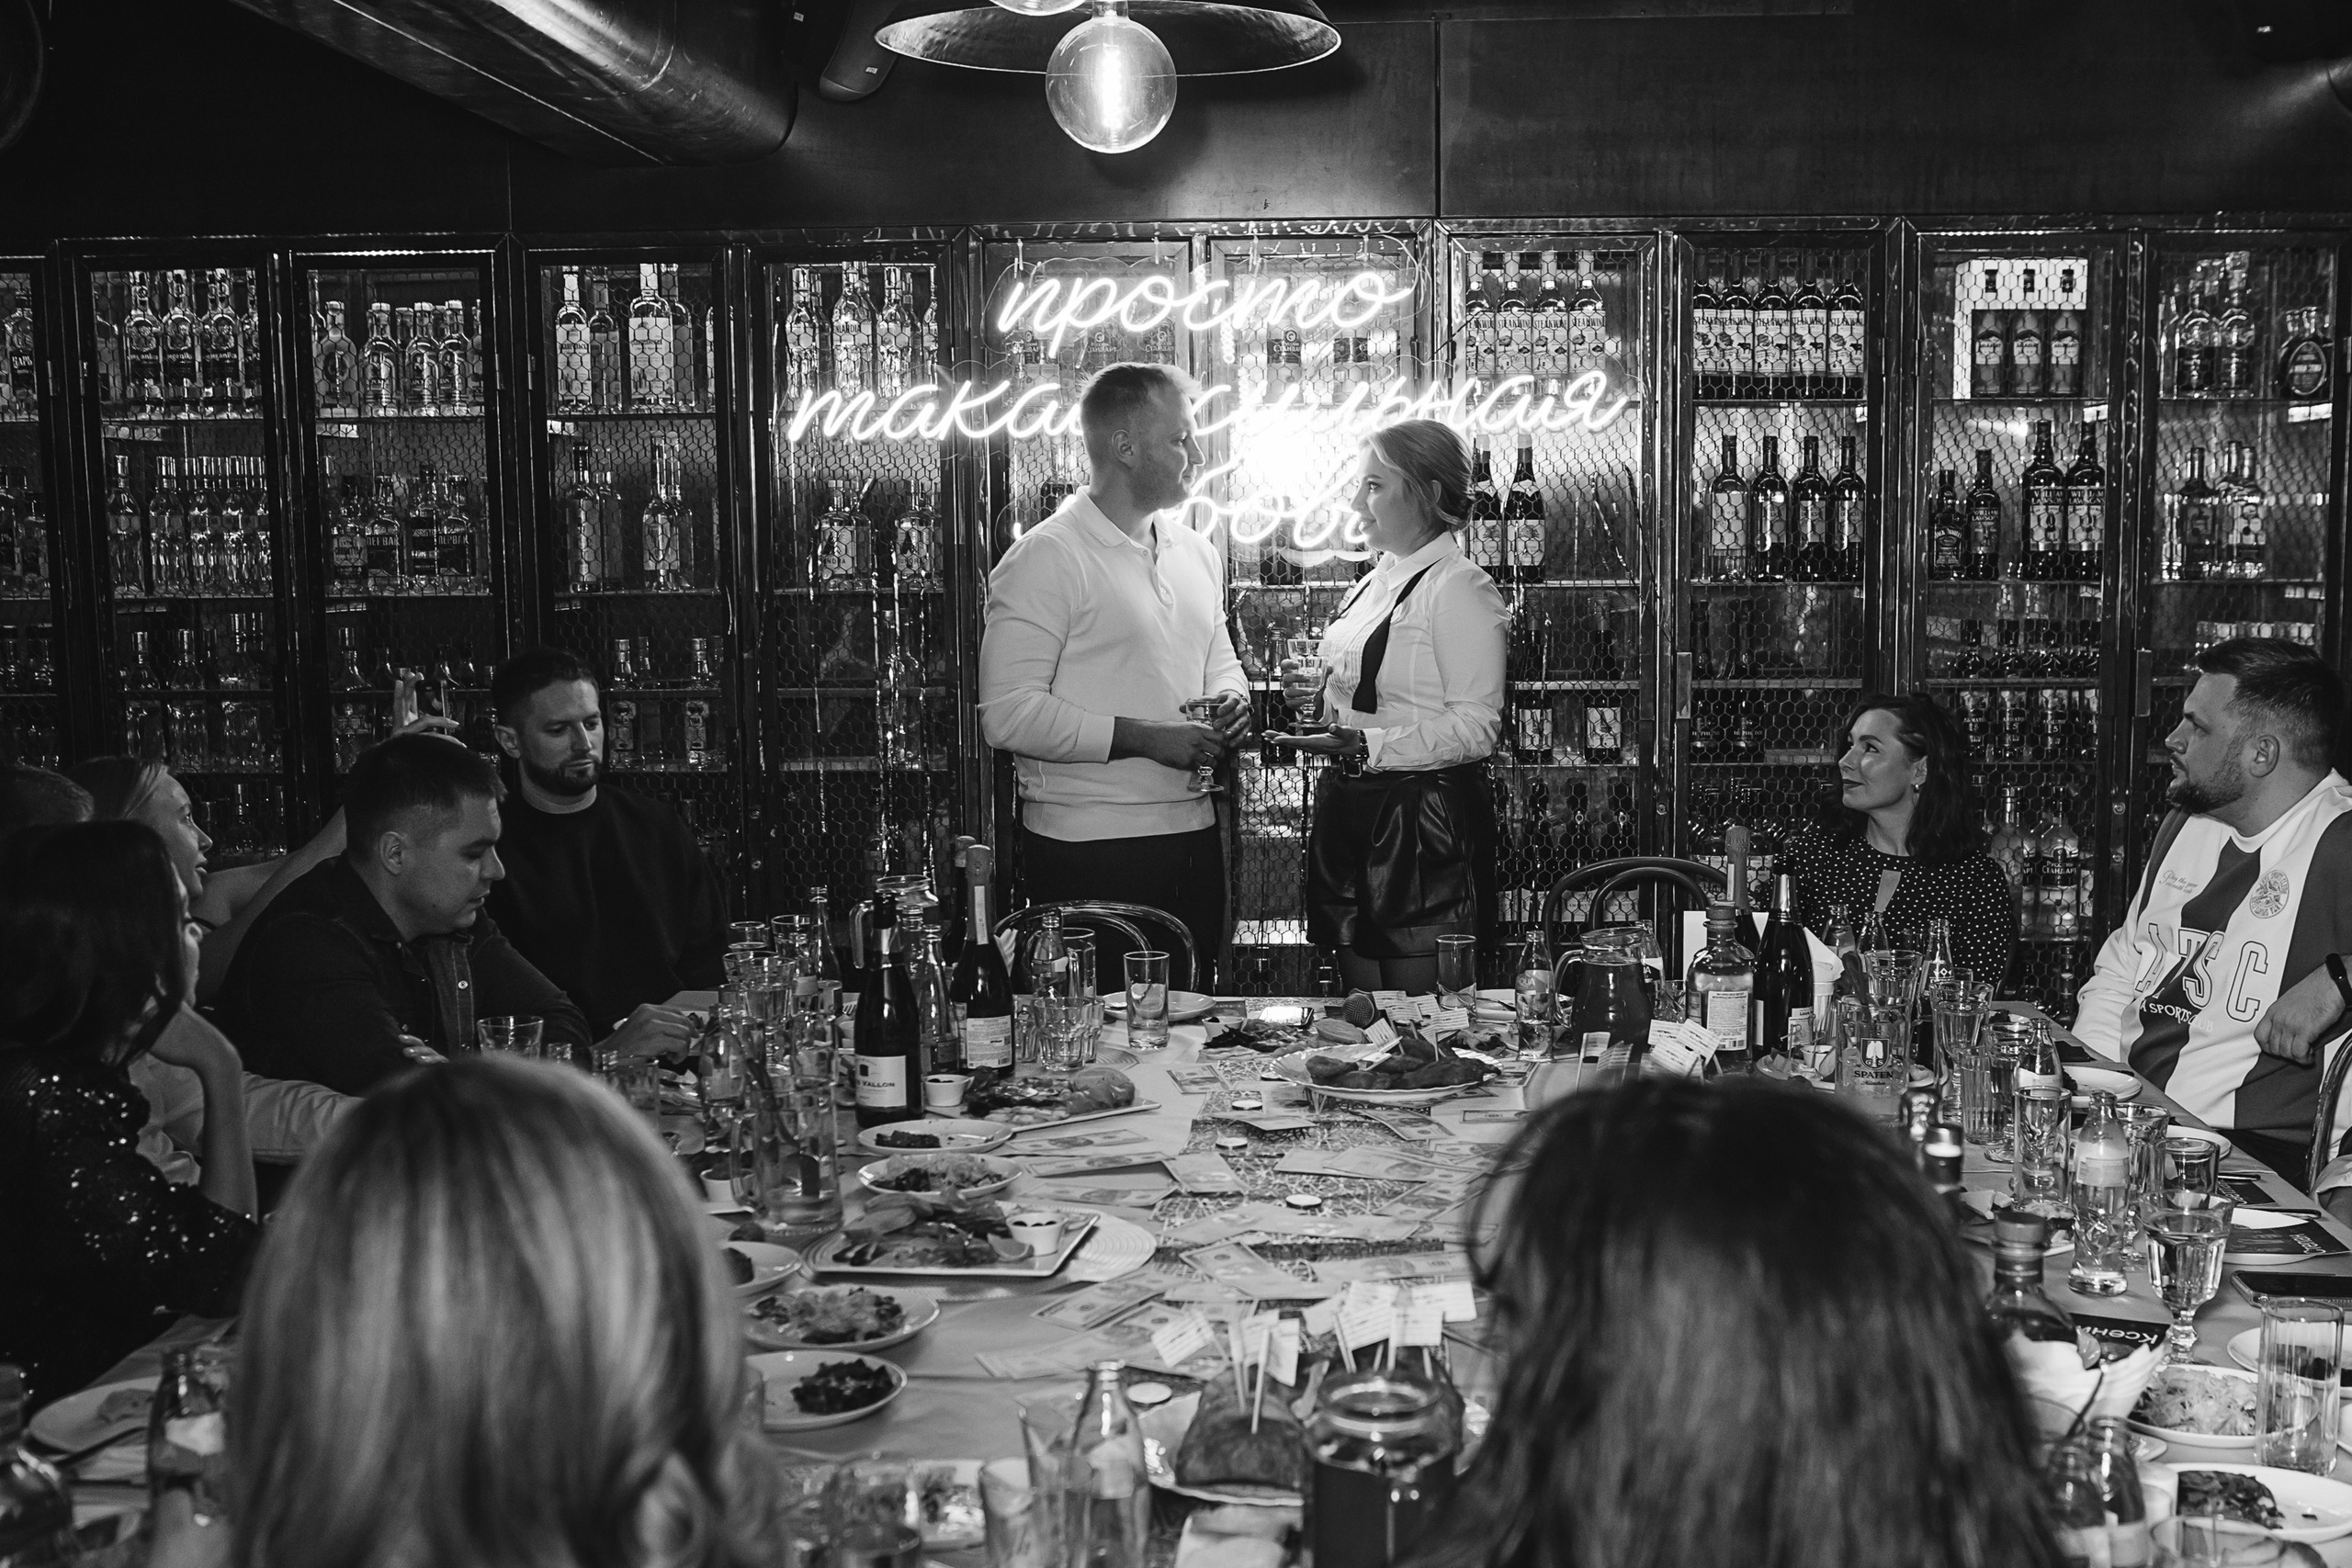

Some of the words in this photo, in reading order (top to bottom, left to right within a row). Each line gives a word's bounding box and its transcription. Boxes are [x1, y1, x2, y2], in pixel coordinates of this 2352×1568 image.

[997, 272, 1412, 358] просто
[788, 379, 1082, 441] така
[2149, 1002, 2193, 1024] SPORTS
[1854, 1070, 1894, 1079] SPATEN
